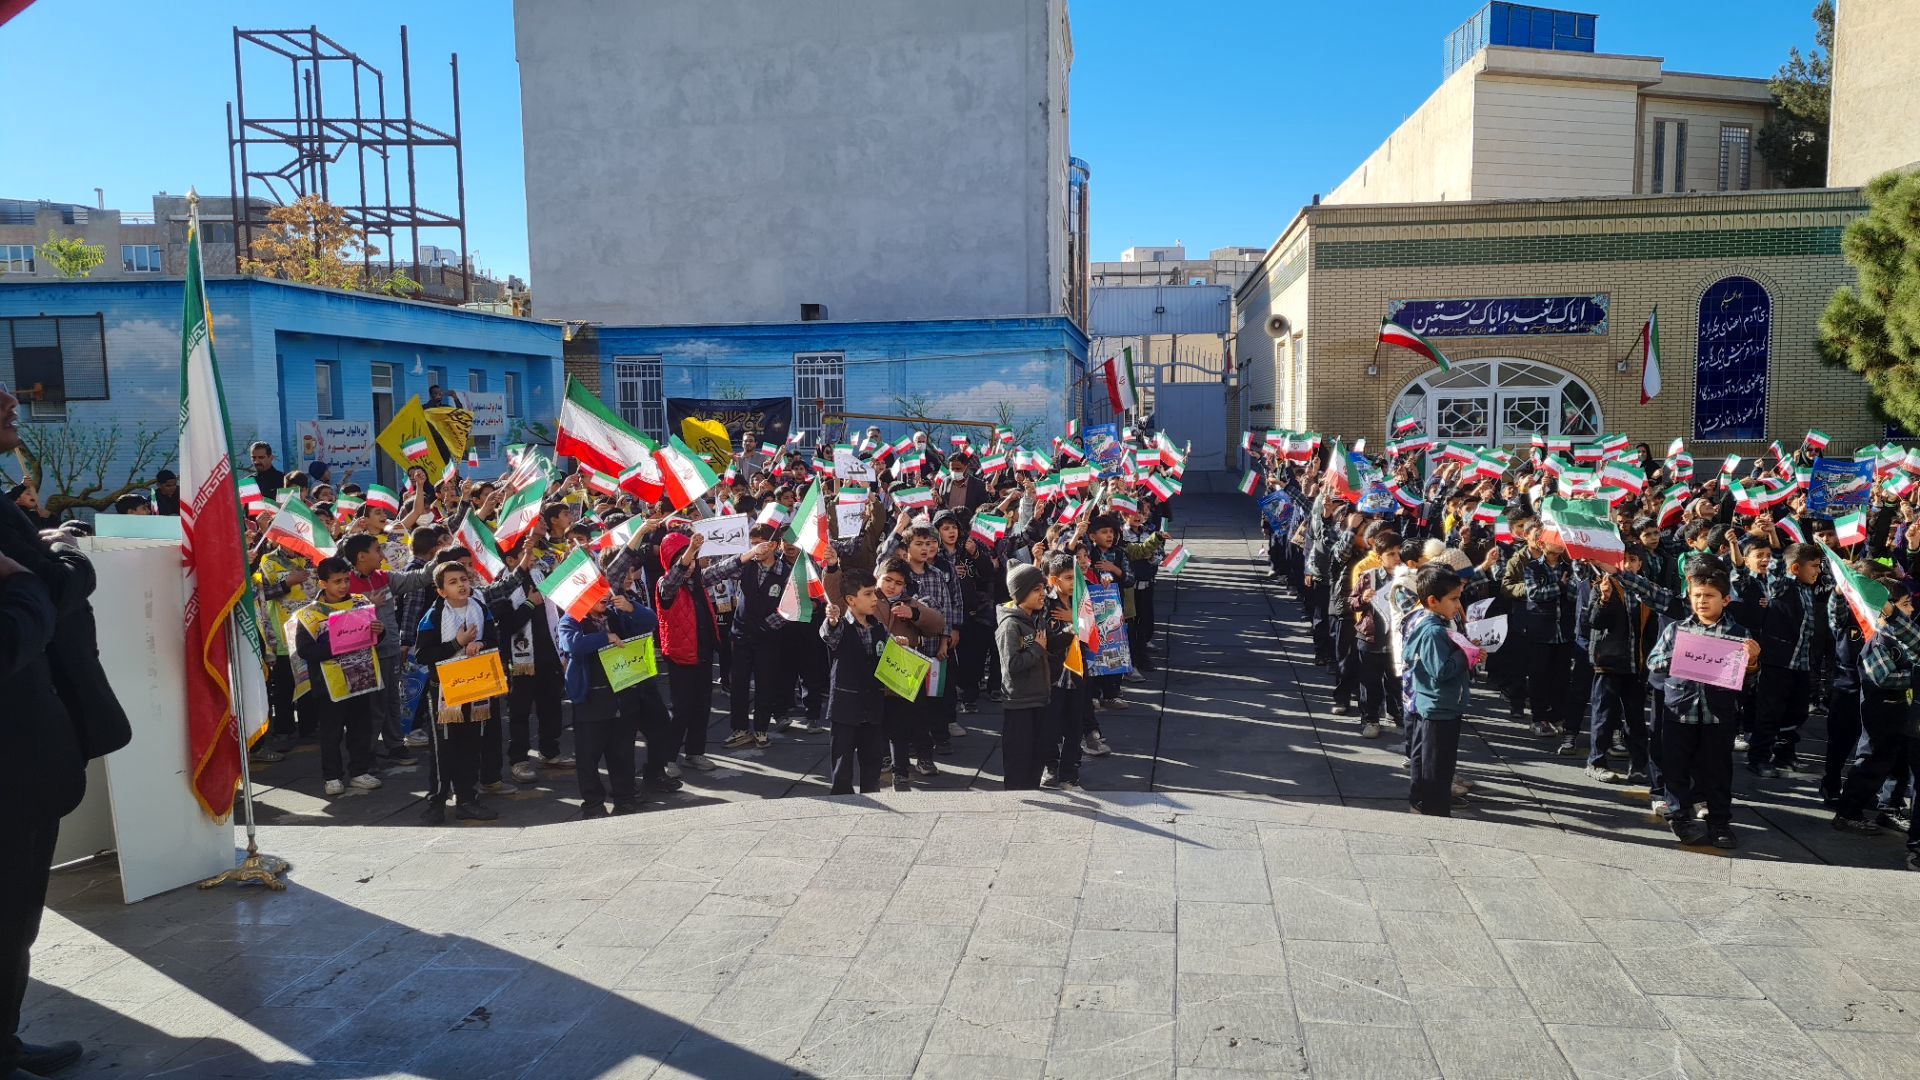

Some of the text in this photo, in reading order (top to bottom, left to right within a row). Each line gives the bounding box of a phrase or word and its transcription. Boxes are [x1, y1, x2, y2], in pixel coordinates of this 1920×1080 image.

[708, 527, 745, 543] امریکا
[631, 655, 644, 663] مرگ
[1714, 656, 1731, 667] مرگ
[476, 671, 491, 679] مرگ
[900, 668, 912, 678] مرگ
